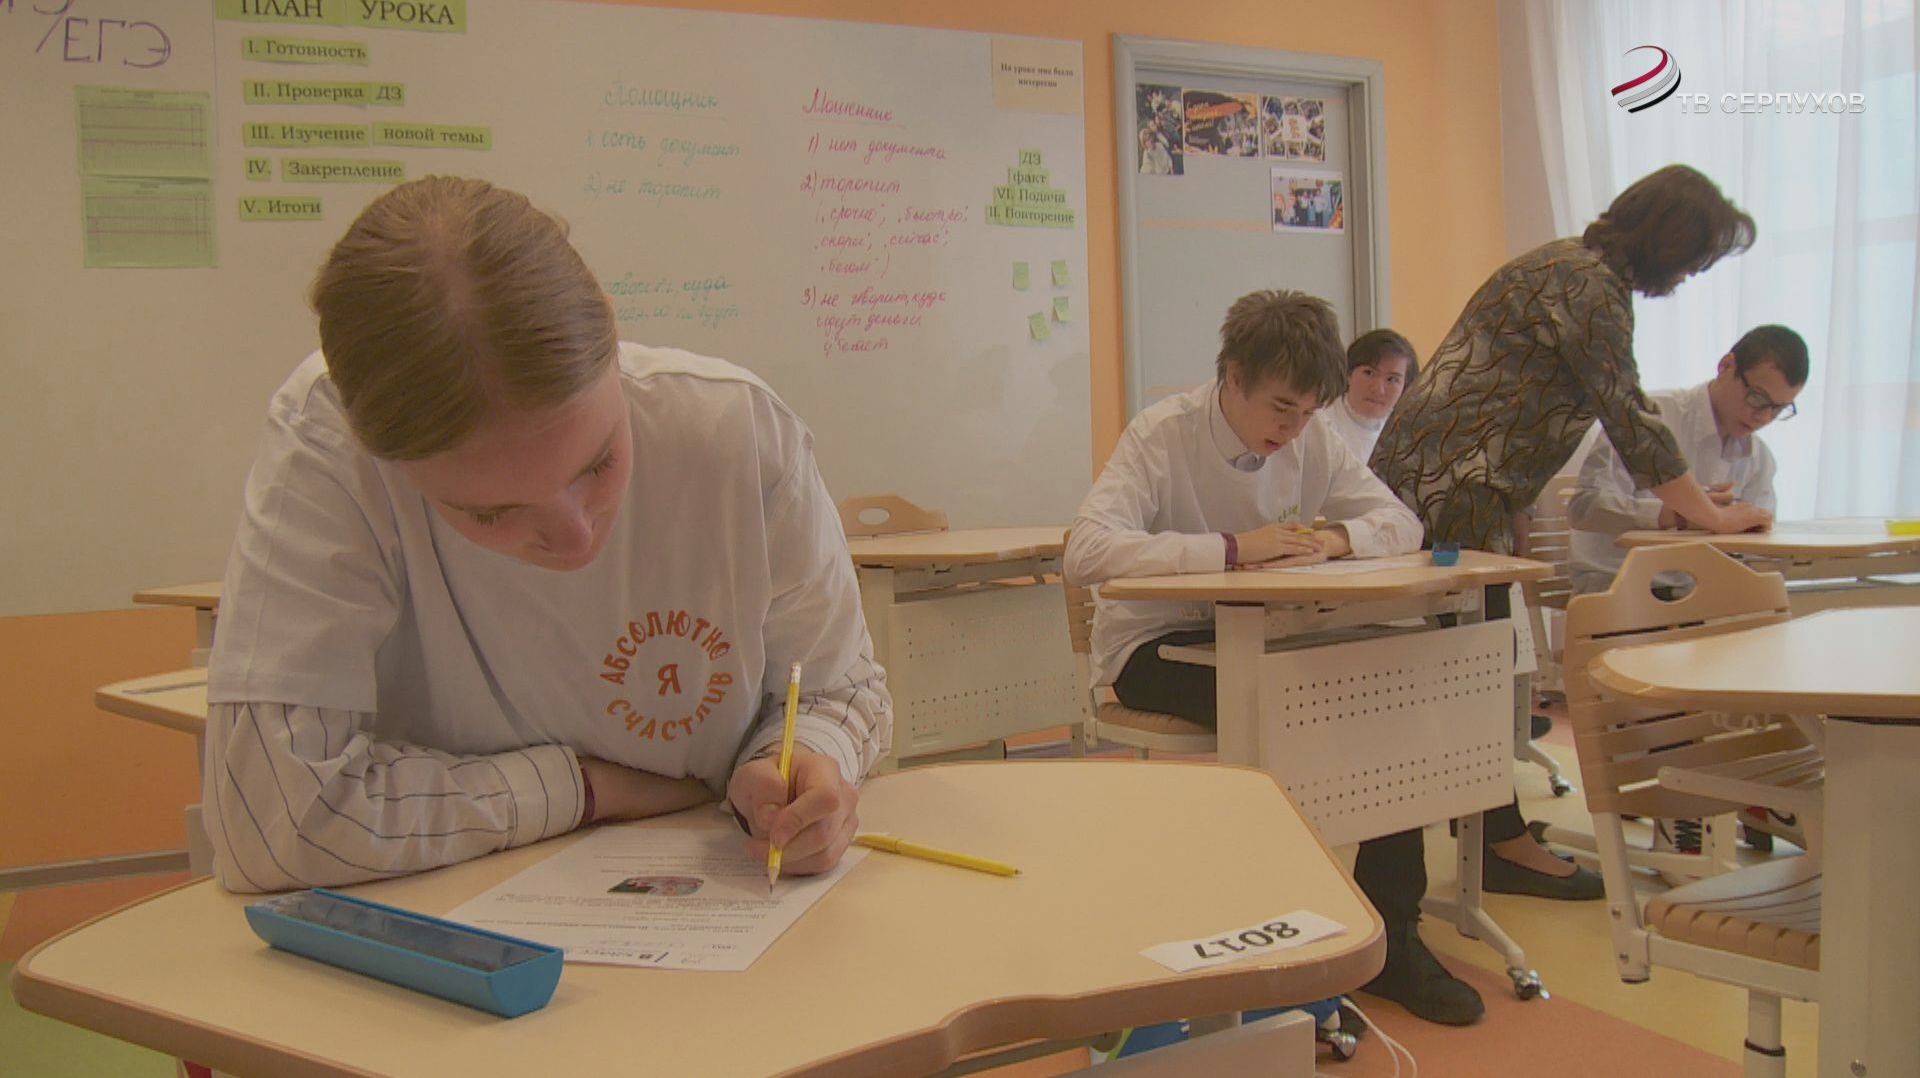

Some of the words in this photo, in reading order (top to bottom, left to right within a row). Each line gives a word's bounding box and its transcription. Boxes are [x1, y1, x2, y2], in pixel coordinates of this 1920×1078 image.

[240, 0, 323, 18] ПЛАН
[361, 0, 455, 25] УРОКА
[266, 40, 366, 60] Готовность
[253, 82, 271, 98] II.
[277, 82, 364, 101] Проверка
[376, 86, 402, 101] ДЗ
[802, 88, 893, 122] Мошенник
[251, 124, 275, 141] III.
[281, 124, 365, 143] Изучение
[383, 128, 434, 142] новой
[440, 132, 485, 144] темы
[808, 132, 820, 159] 1)
[828, 137, 857, 152] нет
[864, 138, 947, 165] документа
[248, 160, 271, 174] IV.
[288, 161, 402, 179] Закрепление
[1013, 170, 1047, 186] факт
[820, 176, 901, 202] торопит
[1019, 188, 1066, 204] Подача
[243, 201, 261, 215] V.
[268, 200, 321, 215] Итоги
[1005, 206, 1075, 224] Повторение
[600, 609, 731, 685] АБСОЛЮТНО
[658, 664, 682, 696] Я
[606, 672, 733, 741] СЧАСТЛИВ
[1193, 921, 1301, 960] 8017
